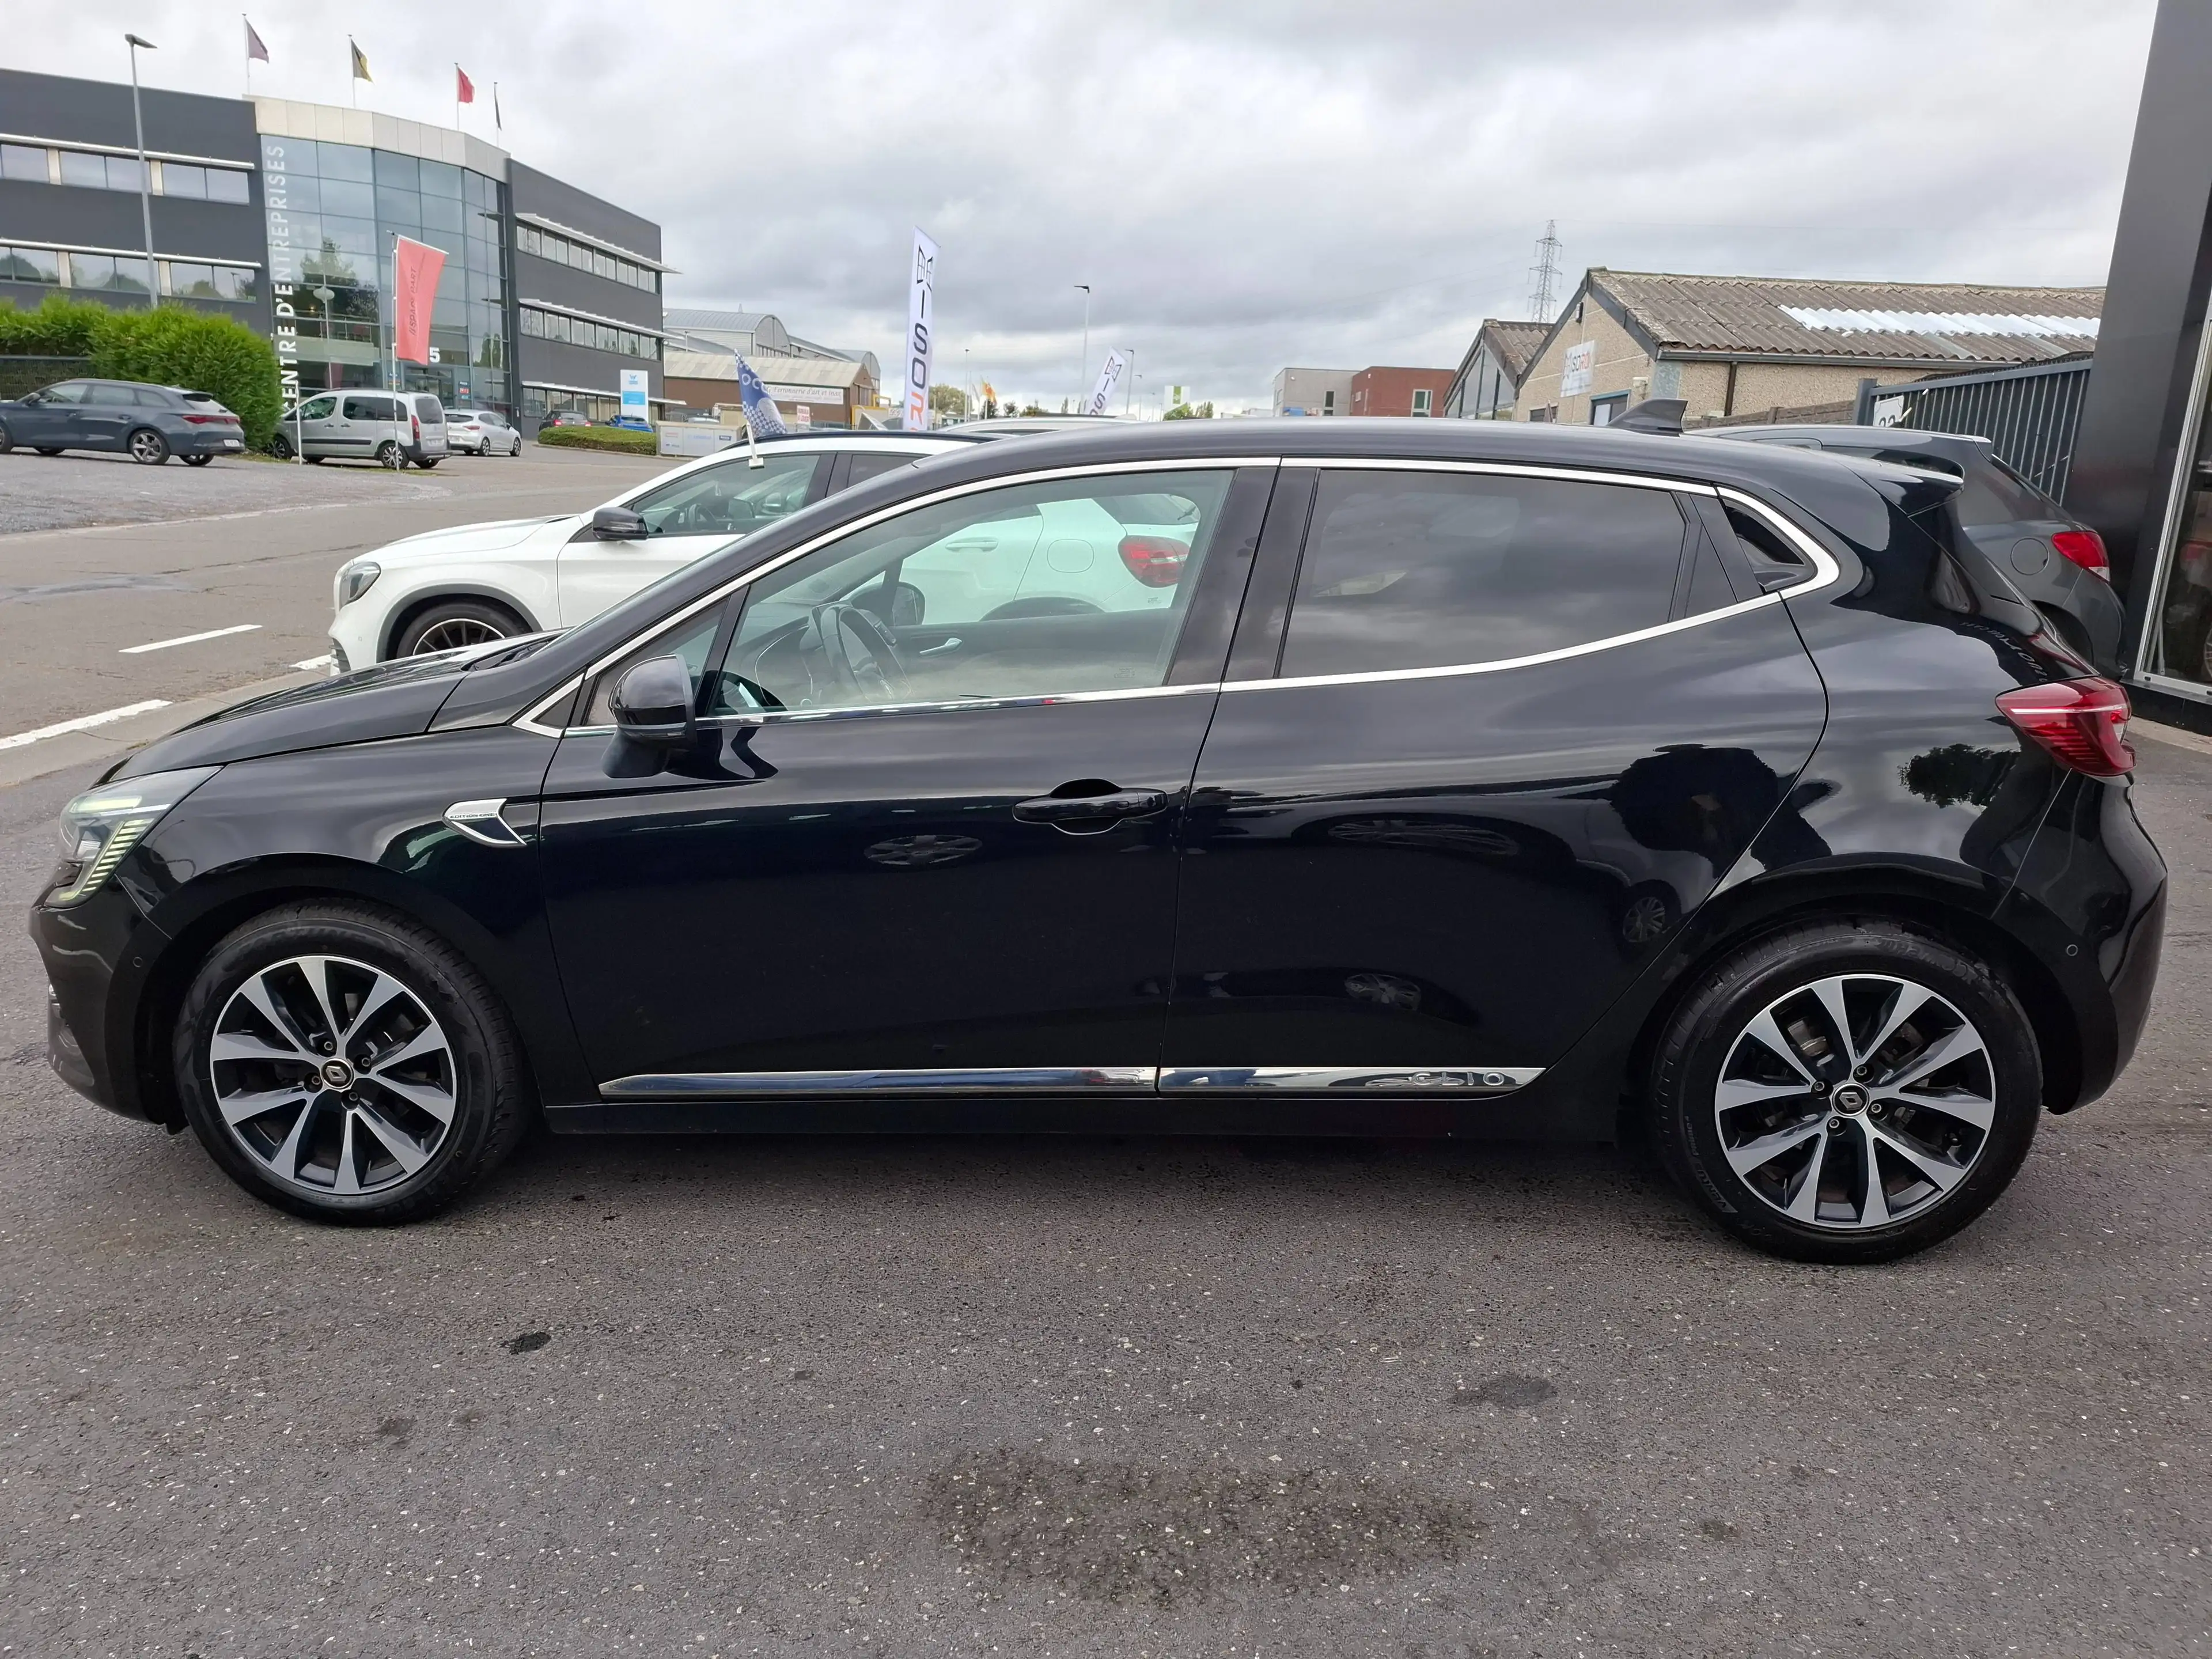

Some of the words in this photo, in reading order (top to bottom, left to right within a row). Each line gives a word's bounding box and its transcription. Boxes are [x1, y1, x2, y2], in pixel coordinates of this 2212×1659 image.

[266, 145, 294, 316] D'ENTREPRISES
[429, 347, 440, 363] 5
[910, 289, 928, 430] ISOR
[1413, 1071, 1505, 1086] CLIO
